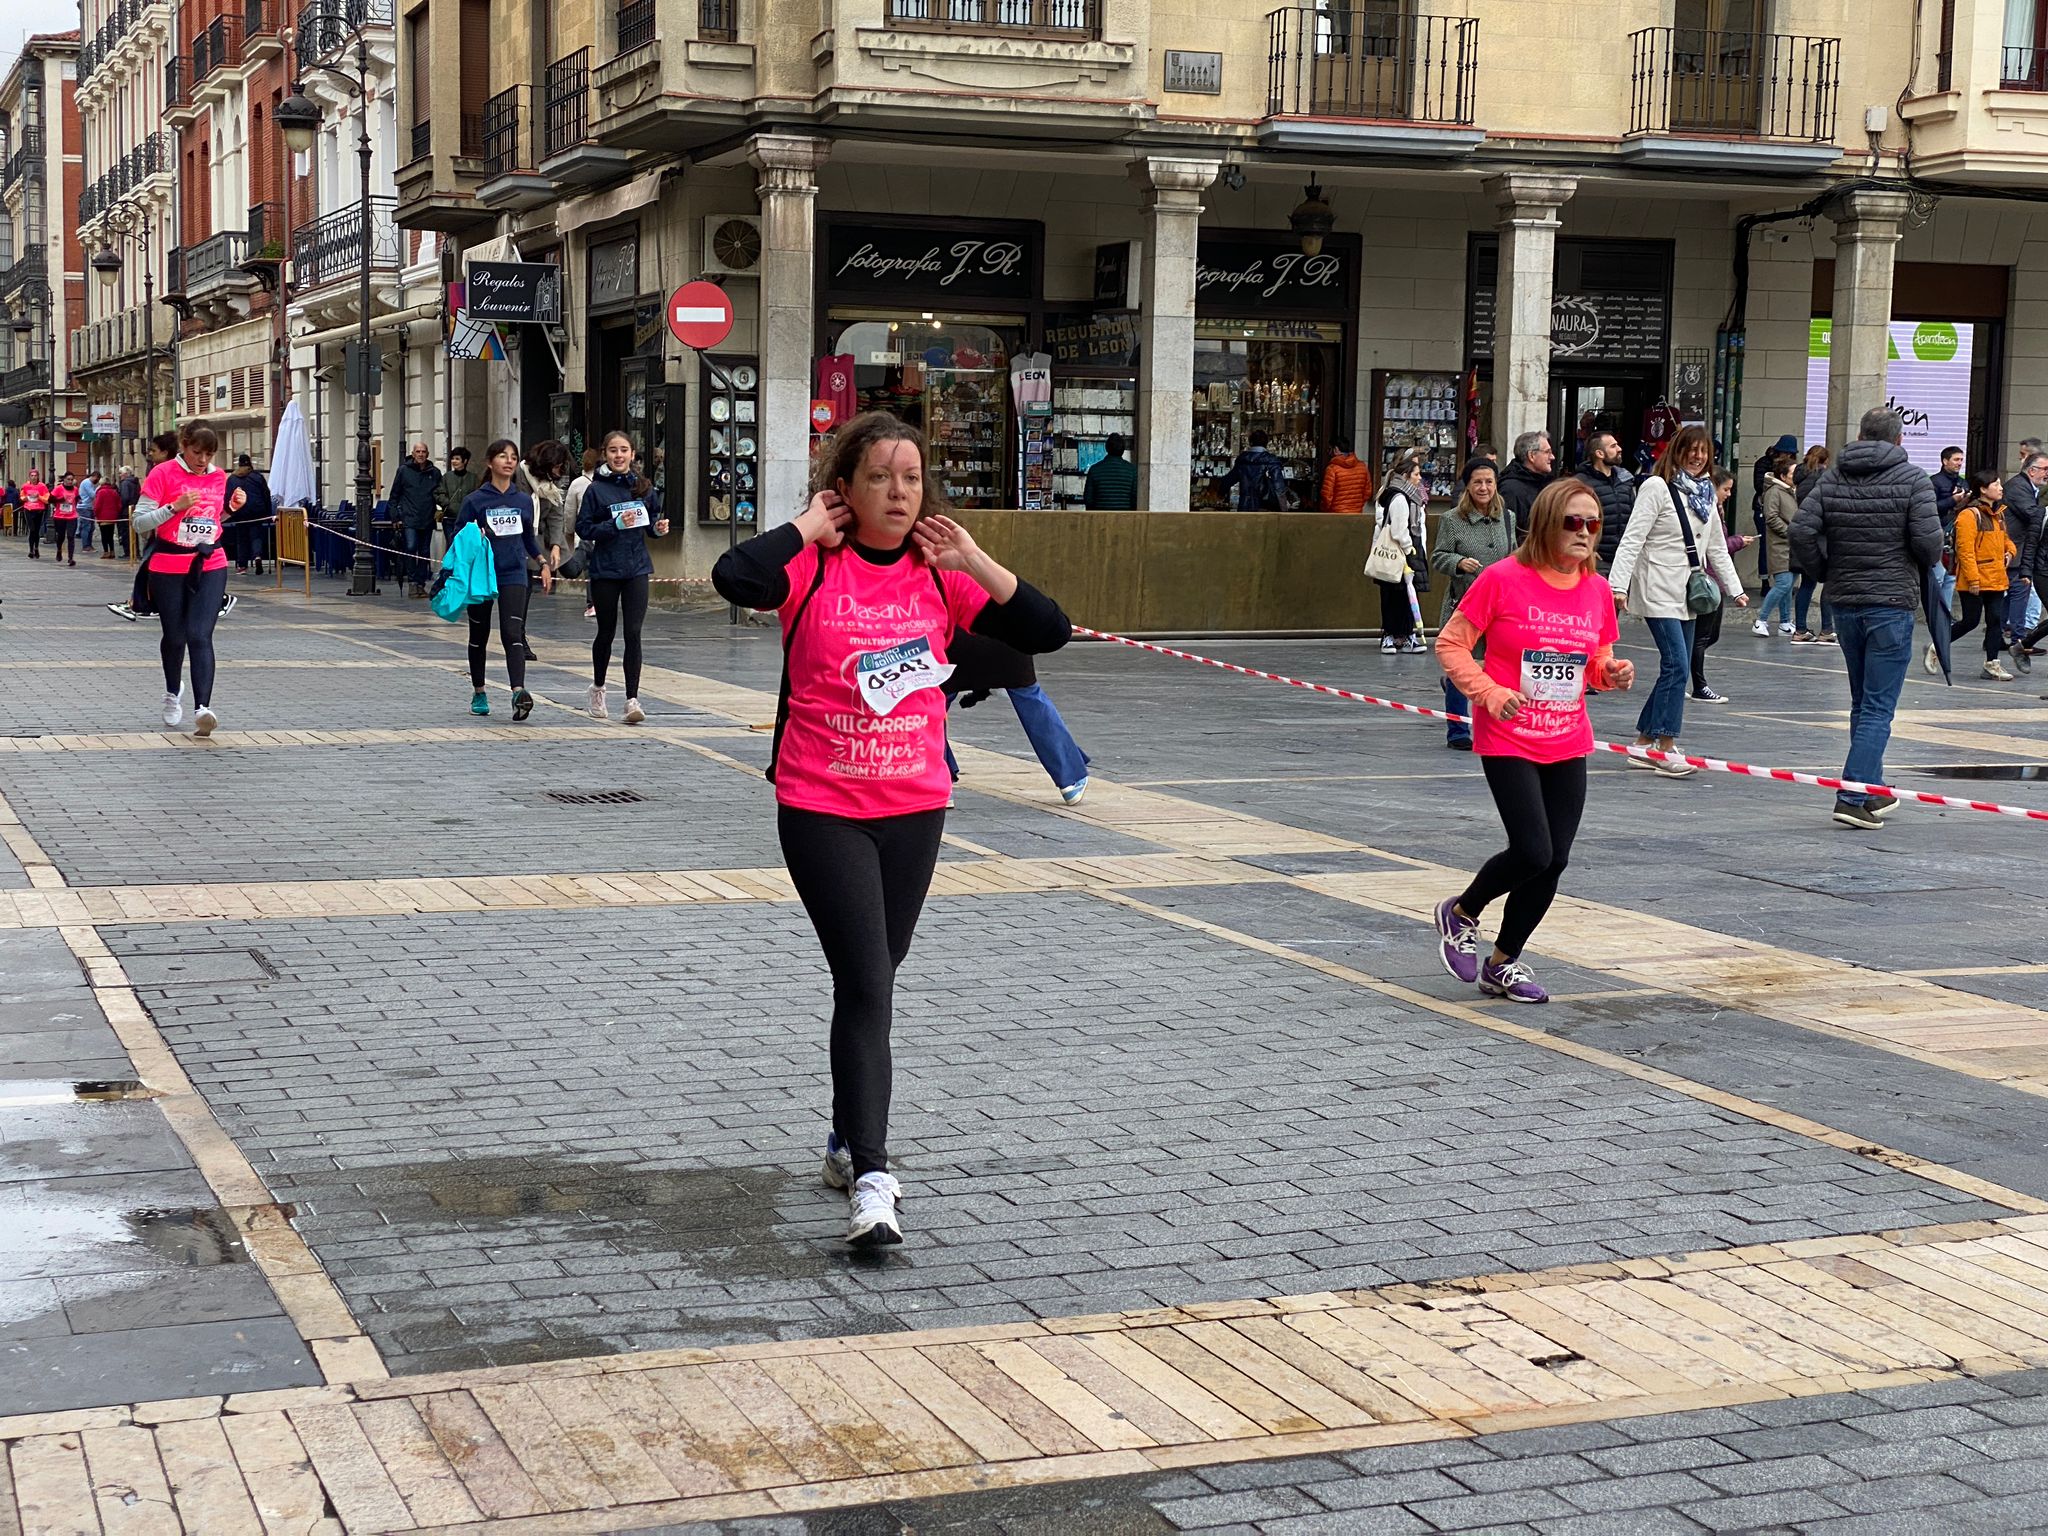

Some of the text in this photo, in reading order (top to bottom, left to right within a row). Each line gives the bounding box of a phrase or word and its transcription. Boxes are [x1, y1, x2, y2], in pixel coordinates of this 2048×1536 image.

[1178, 66, 1208, 74] PLAZA
[1171, 78, 1215, 87] DE REGLA
[472, 270, 525, 293] Regalos
[473, 295, 531, 312] Souvenir
[1551, 314, 1587, 332] NAURA
[1057, 338, 1130, 360] DE LEON
[1019, 371, 1046, 381] LEON
[186, 524, 212, 534] 1092
[492, 516, 517, 526] 5649
[1528, 606, 1593, 628] Drasanvi
[868, 658, 930, 690] 0543
[1531, 665, 1575, 681] 3936
[825, 713, 929, 733] VIII CARRERA
[847, 736, 916, 766] Mujer
